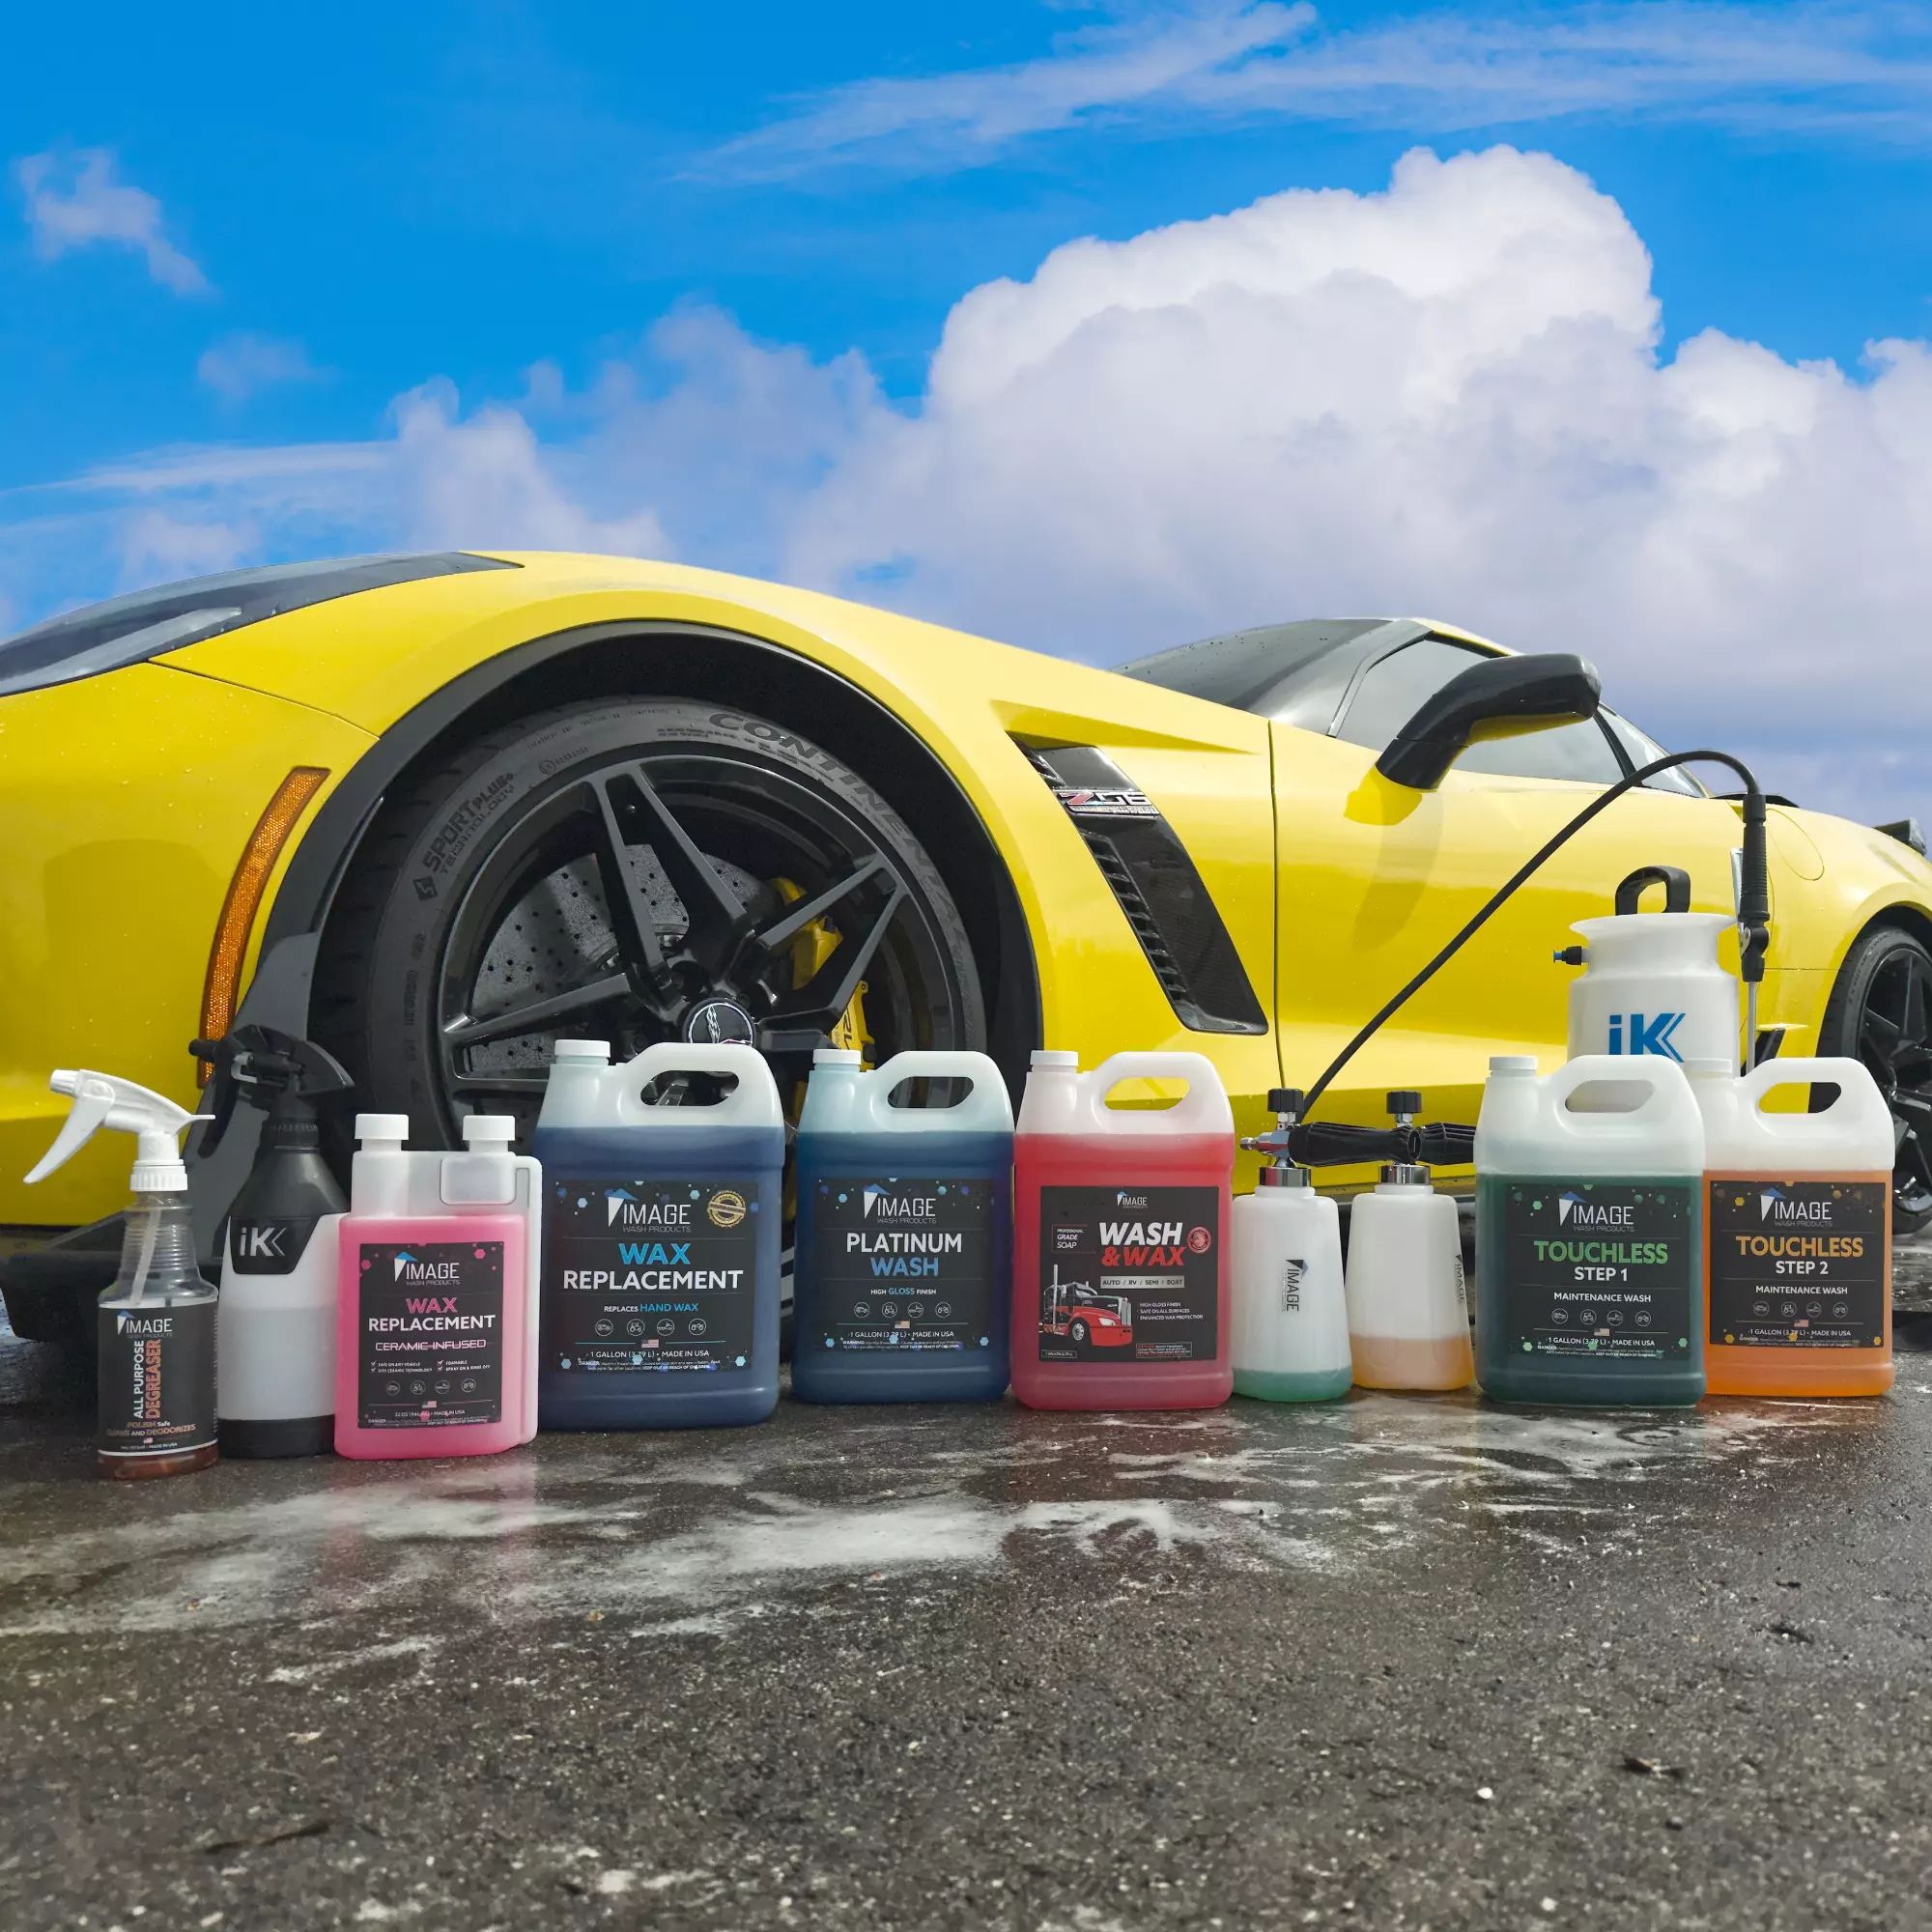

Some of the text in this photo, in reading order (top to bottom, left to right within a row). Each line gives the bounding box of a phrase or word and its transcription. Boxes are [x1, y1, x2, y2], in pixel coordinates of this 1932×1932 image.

[876, 1198, 937, 1217] IMAGE
[1122, 1197, 1148, 1207] IMAGE
[1775, 1202, 1833, 1220] IMAGE
[623, 1204, 692, 1225] IMAGE
[1573, 1206, 1634, 1225] IMAGE
[846, 1233, 962, 1253] PLATINUM
[1099, 1222, 1183, 1246] WASH
[618, 1243, 692, 1265] WAX
[1534, 1240, 1668, 1264] TOUCHLESS
[1736, 1236, 1863, 1257] TOUCHLESS
[406, 1263, 460, 1280] IMAGE
[869, 1257, 939, 1276] WASH
[1575, 1266, 1628, 1281] STEP 1
[1776, 1261, 1829, 1274] STEP 2
[563, 1270, 744, 1290] REPLACEMENT
[1286, 1268, 1299, 1312] IMAGE
[1553, 1293, 1651, 1303] MAINTENANCE WASH
[1755, 1286, 1821, 1294] MAINTENANCE
[406, 1297, 457, 1314] WAX
[639, 1303, 671, 1312] HAND
[673, 1303, 698, 1312] WAX
[127, 1319, 173, 1334] IMAGE
[368, 1315, 496, 1331] REPLACEMENT
[375, 1339, 486, 1351] CERAMIC INFUSED
[133, 1340, 145, 1419] ALL PURPOSE
[145, 1338, 161, 1419] DEGREASER
[146, 1424, 196, 1435] DEODORIZES
